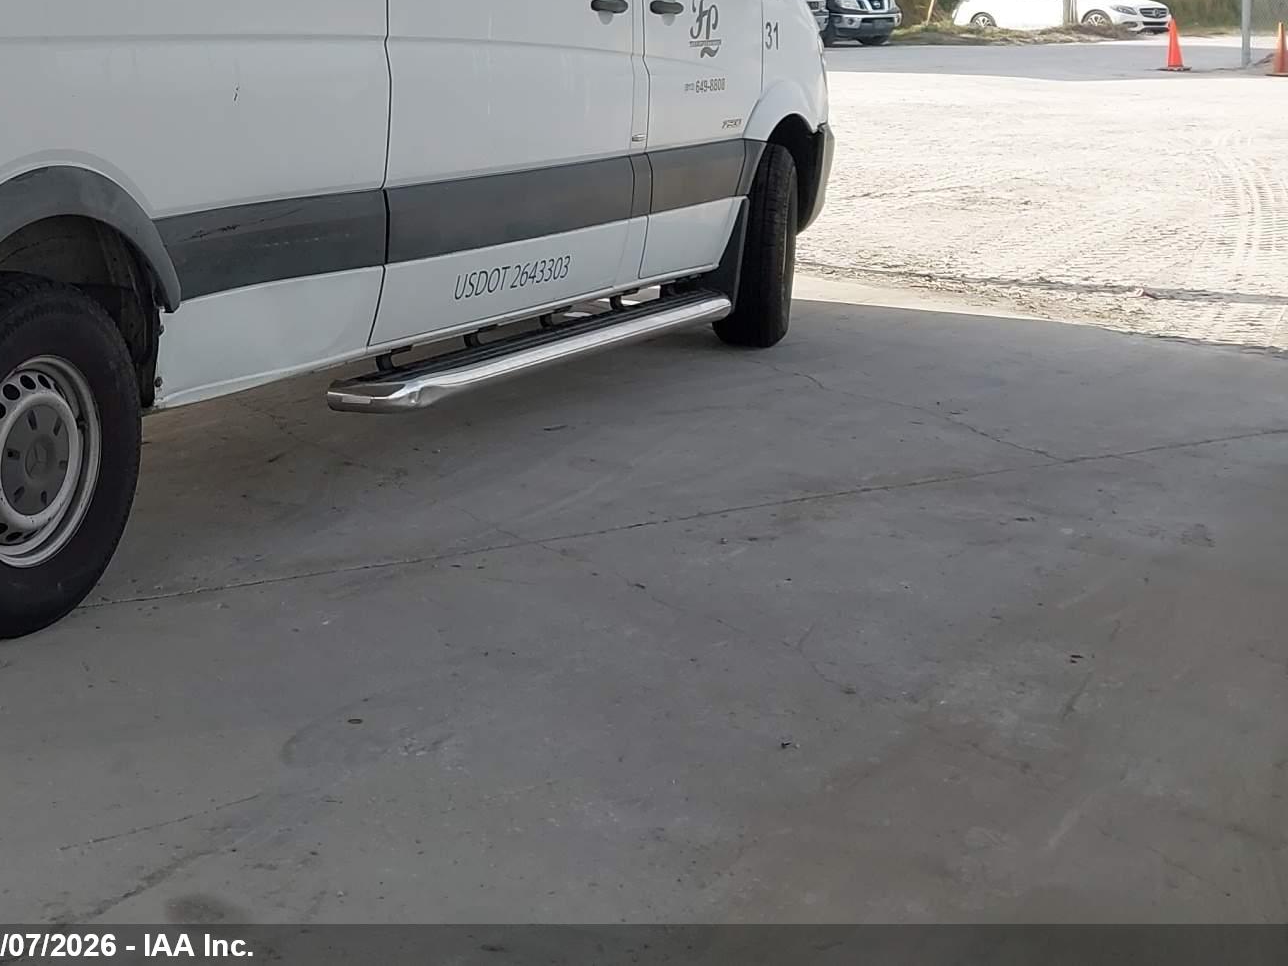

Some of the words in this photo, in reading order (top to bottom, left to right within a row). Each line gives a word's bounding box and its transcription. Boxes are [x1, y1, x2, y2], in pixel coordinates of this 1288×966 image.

[765, 22, 779, 51] 31
[454, 265, 511, 300] USDOT
[510, 255, 571, 290] 2643303
